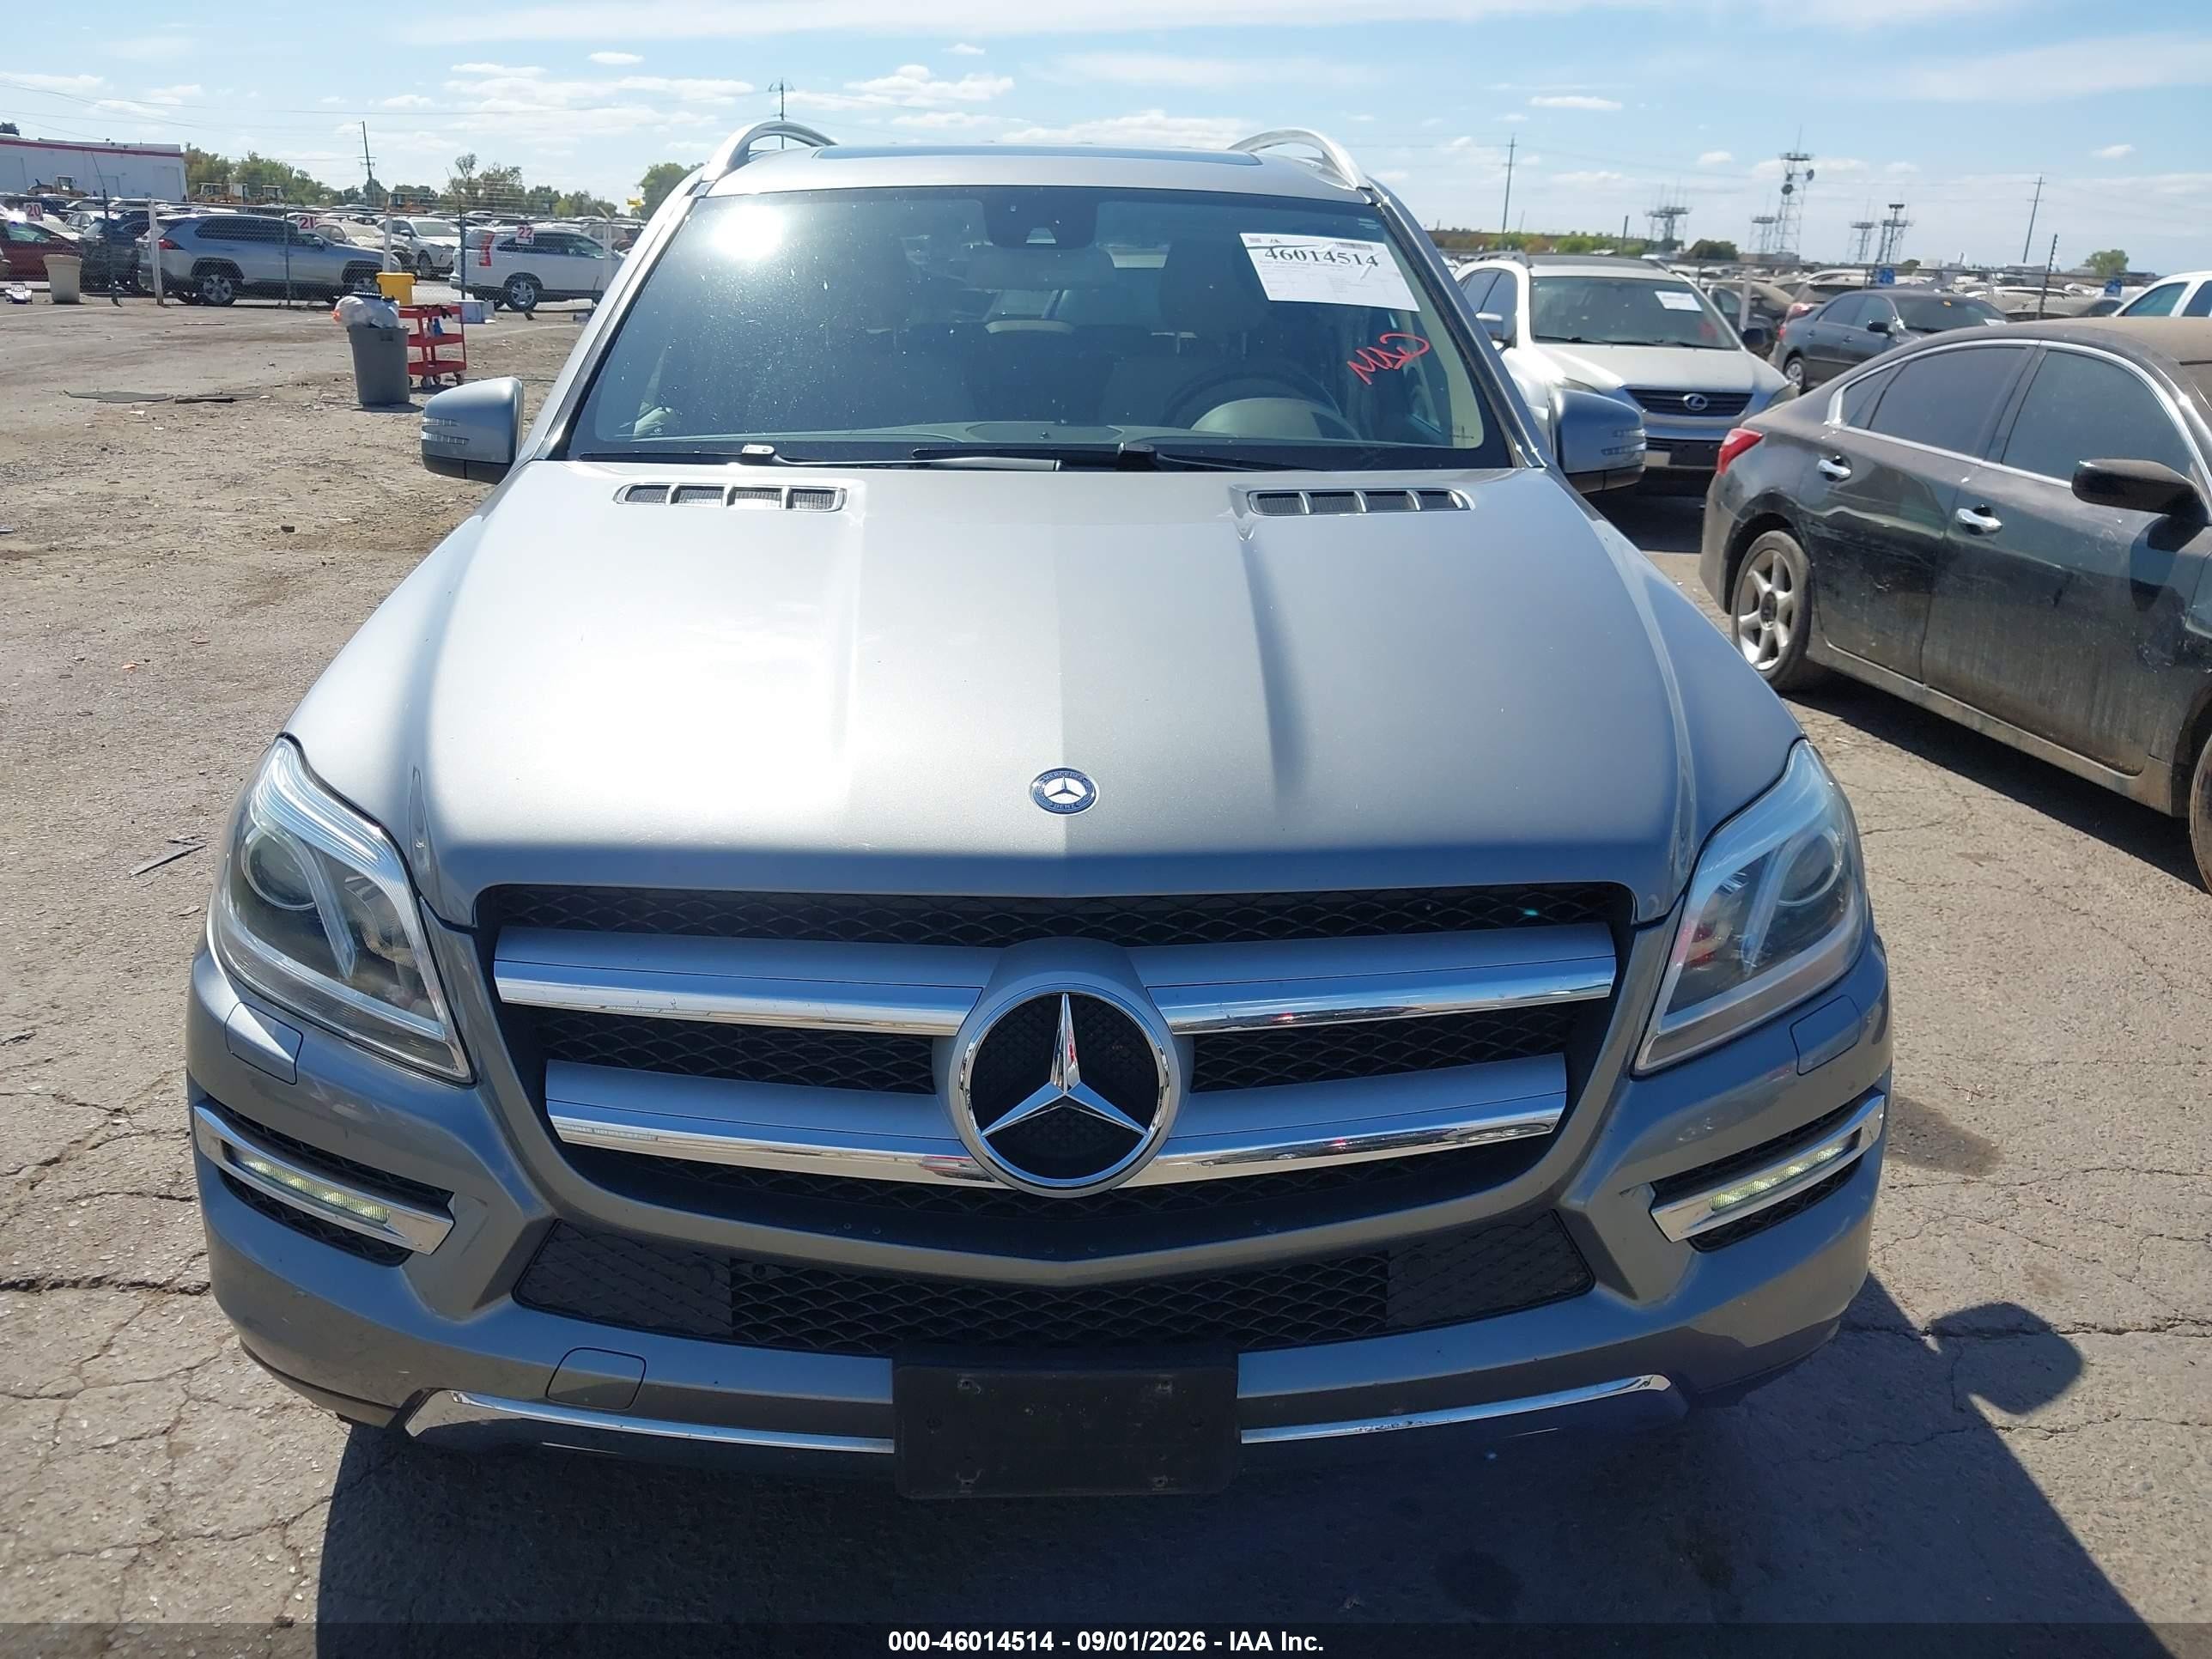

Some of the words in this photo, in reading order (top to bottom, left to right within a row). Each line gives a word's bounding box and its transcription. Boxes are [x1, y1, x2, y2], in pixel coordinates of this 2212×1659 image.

[27, 204, 41, 216] 20
[299, 217, 314, 229] 21
[519, 227, 532, 239] 22
[1264, 246, 1379, 267] 46014514
